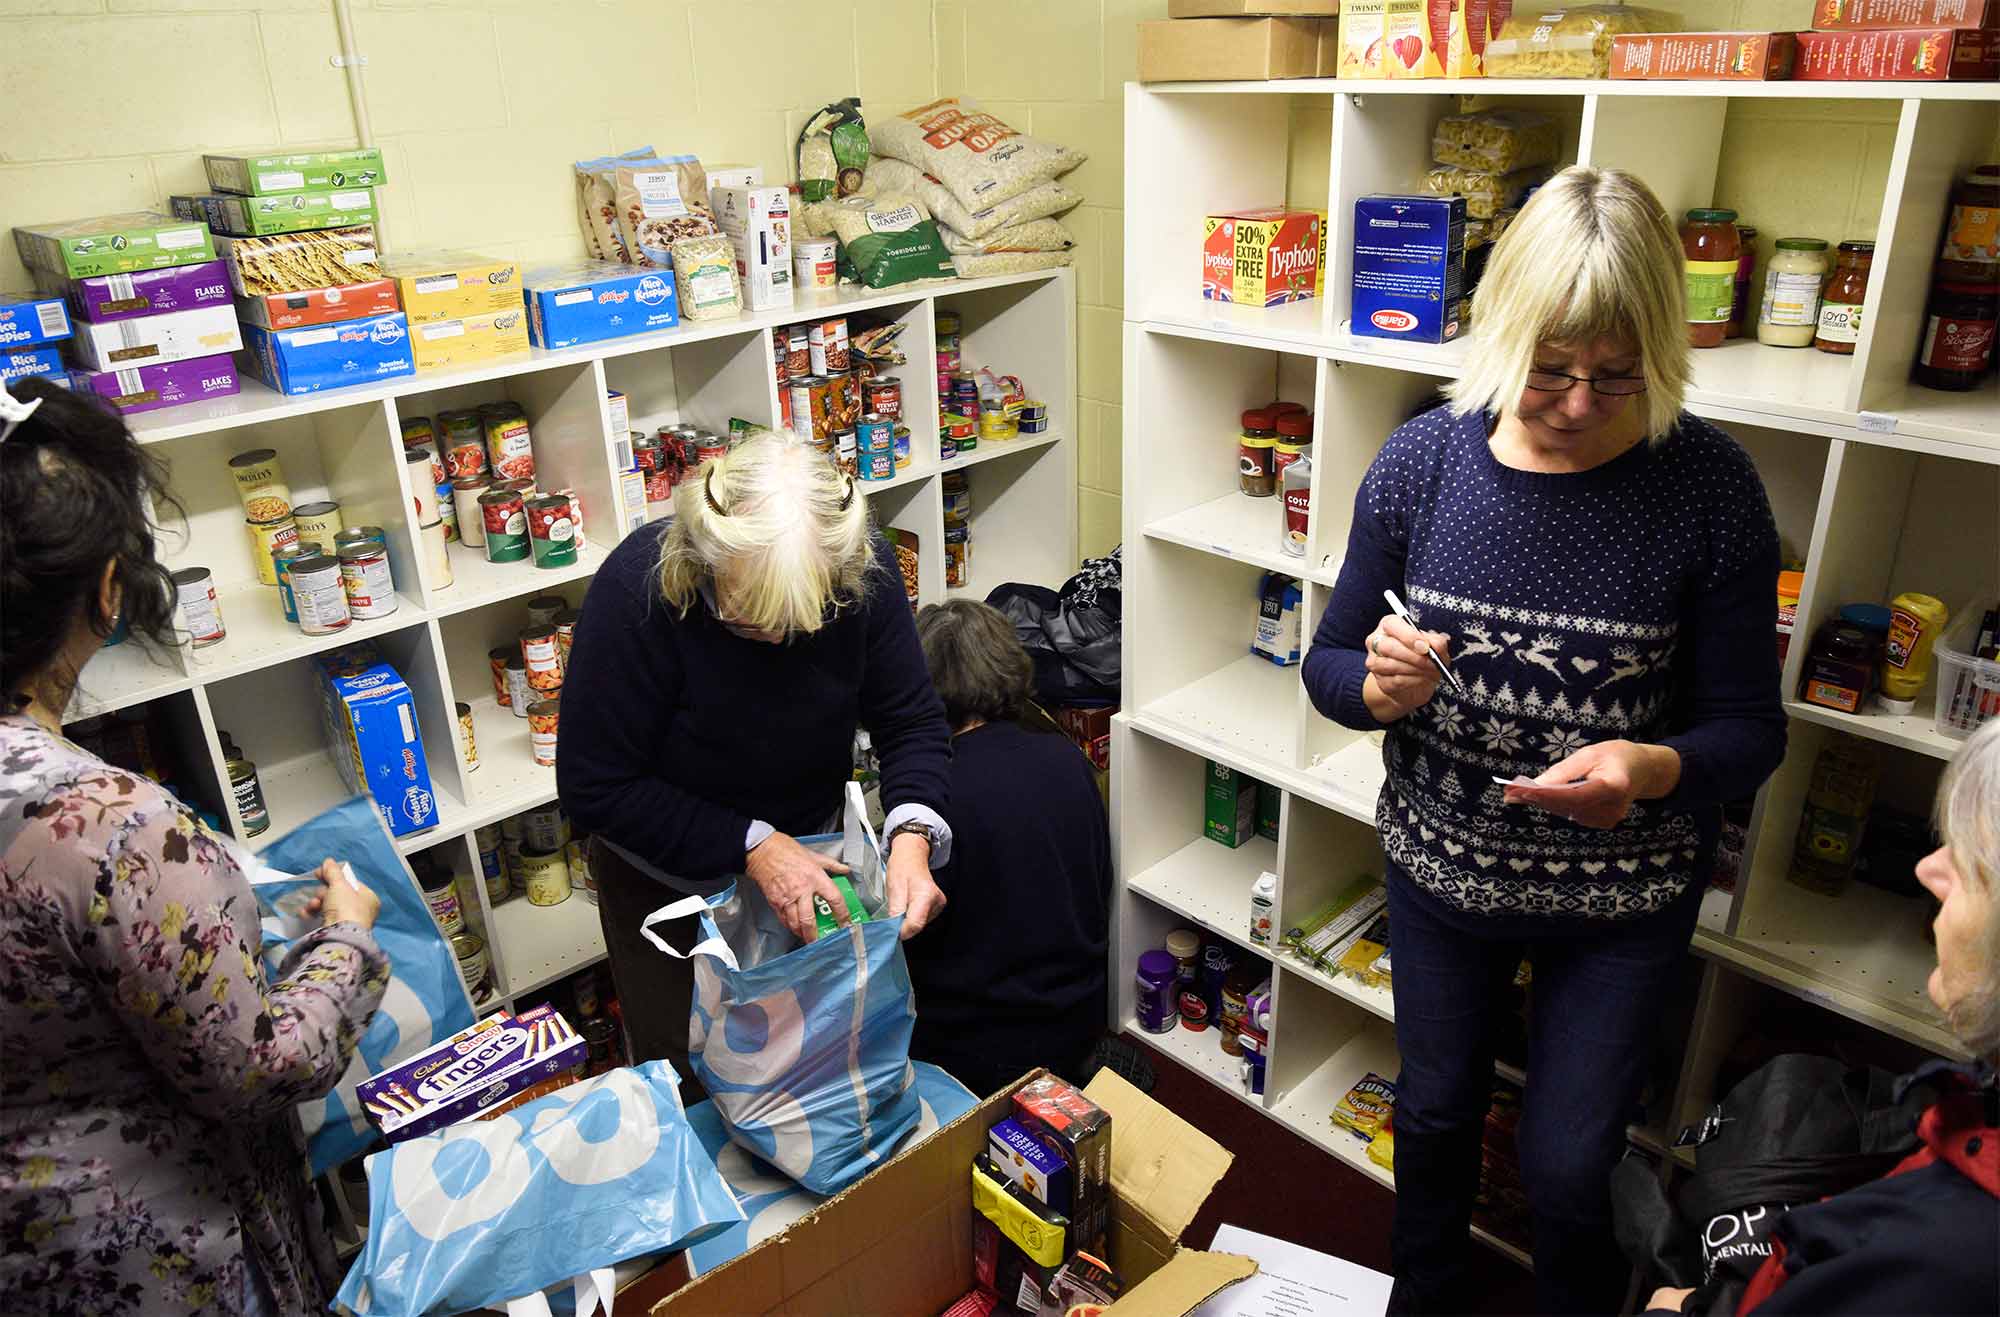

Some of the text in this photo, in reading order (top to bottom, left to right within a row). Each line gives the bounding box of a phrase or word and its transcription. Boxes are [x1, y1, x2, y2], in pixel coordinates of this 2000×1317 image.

[1351, 4, 1384, 12] TWINING
[1236, 226, 1265, 245] 50%
[1236, 246, 1263, 260] EXTRA
[1235, 260, 1263, 279] FREE
[195, 285, 225, 298] FLAKES
[10, 355, 37, 367] Rice
[202, 376, 232, 389] FLAKES
[419, 791, 430, 814] Rice
[412, 1056, 453, 1079] Cadbury
[426, 1032, 518, 1092] fingers
[1356, 1082, 1395, 1104] SUPER
